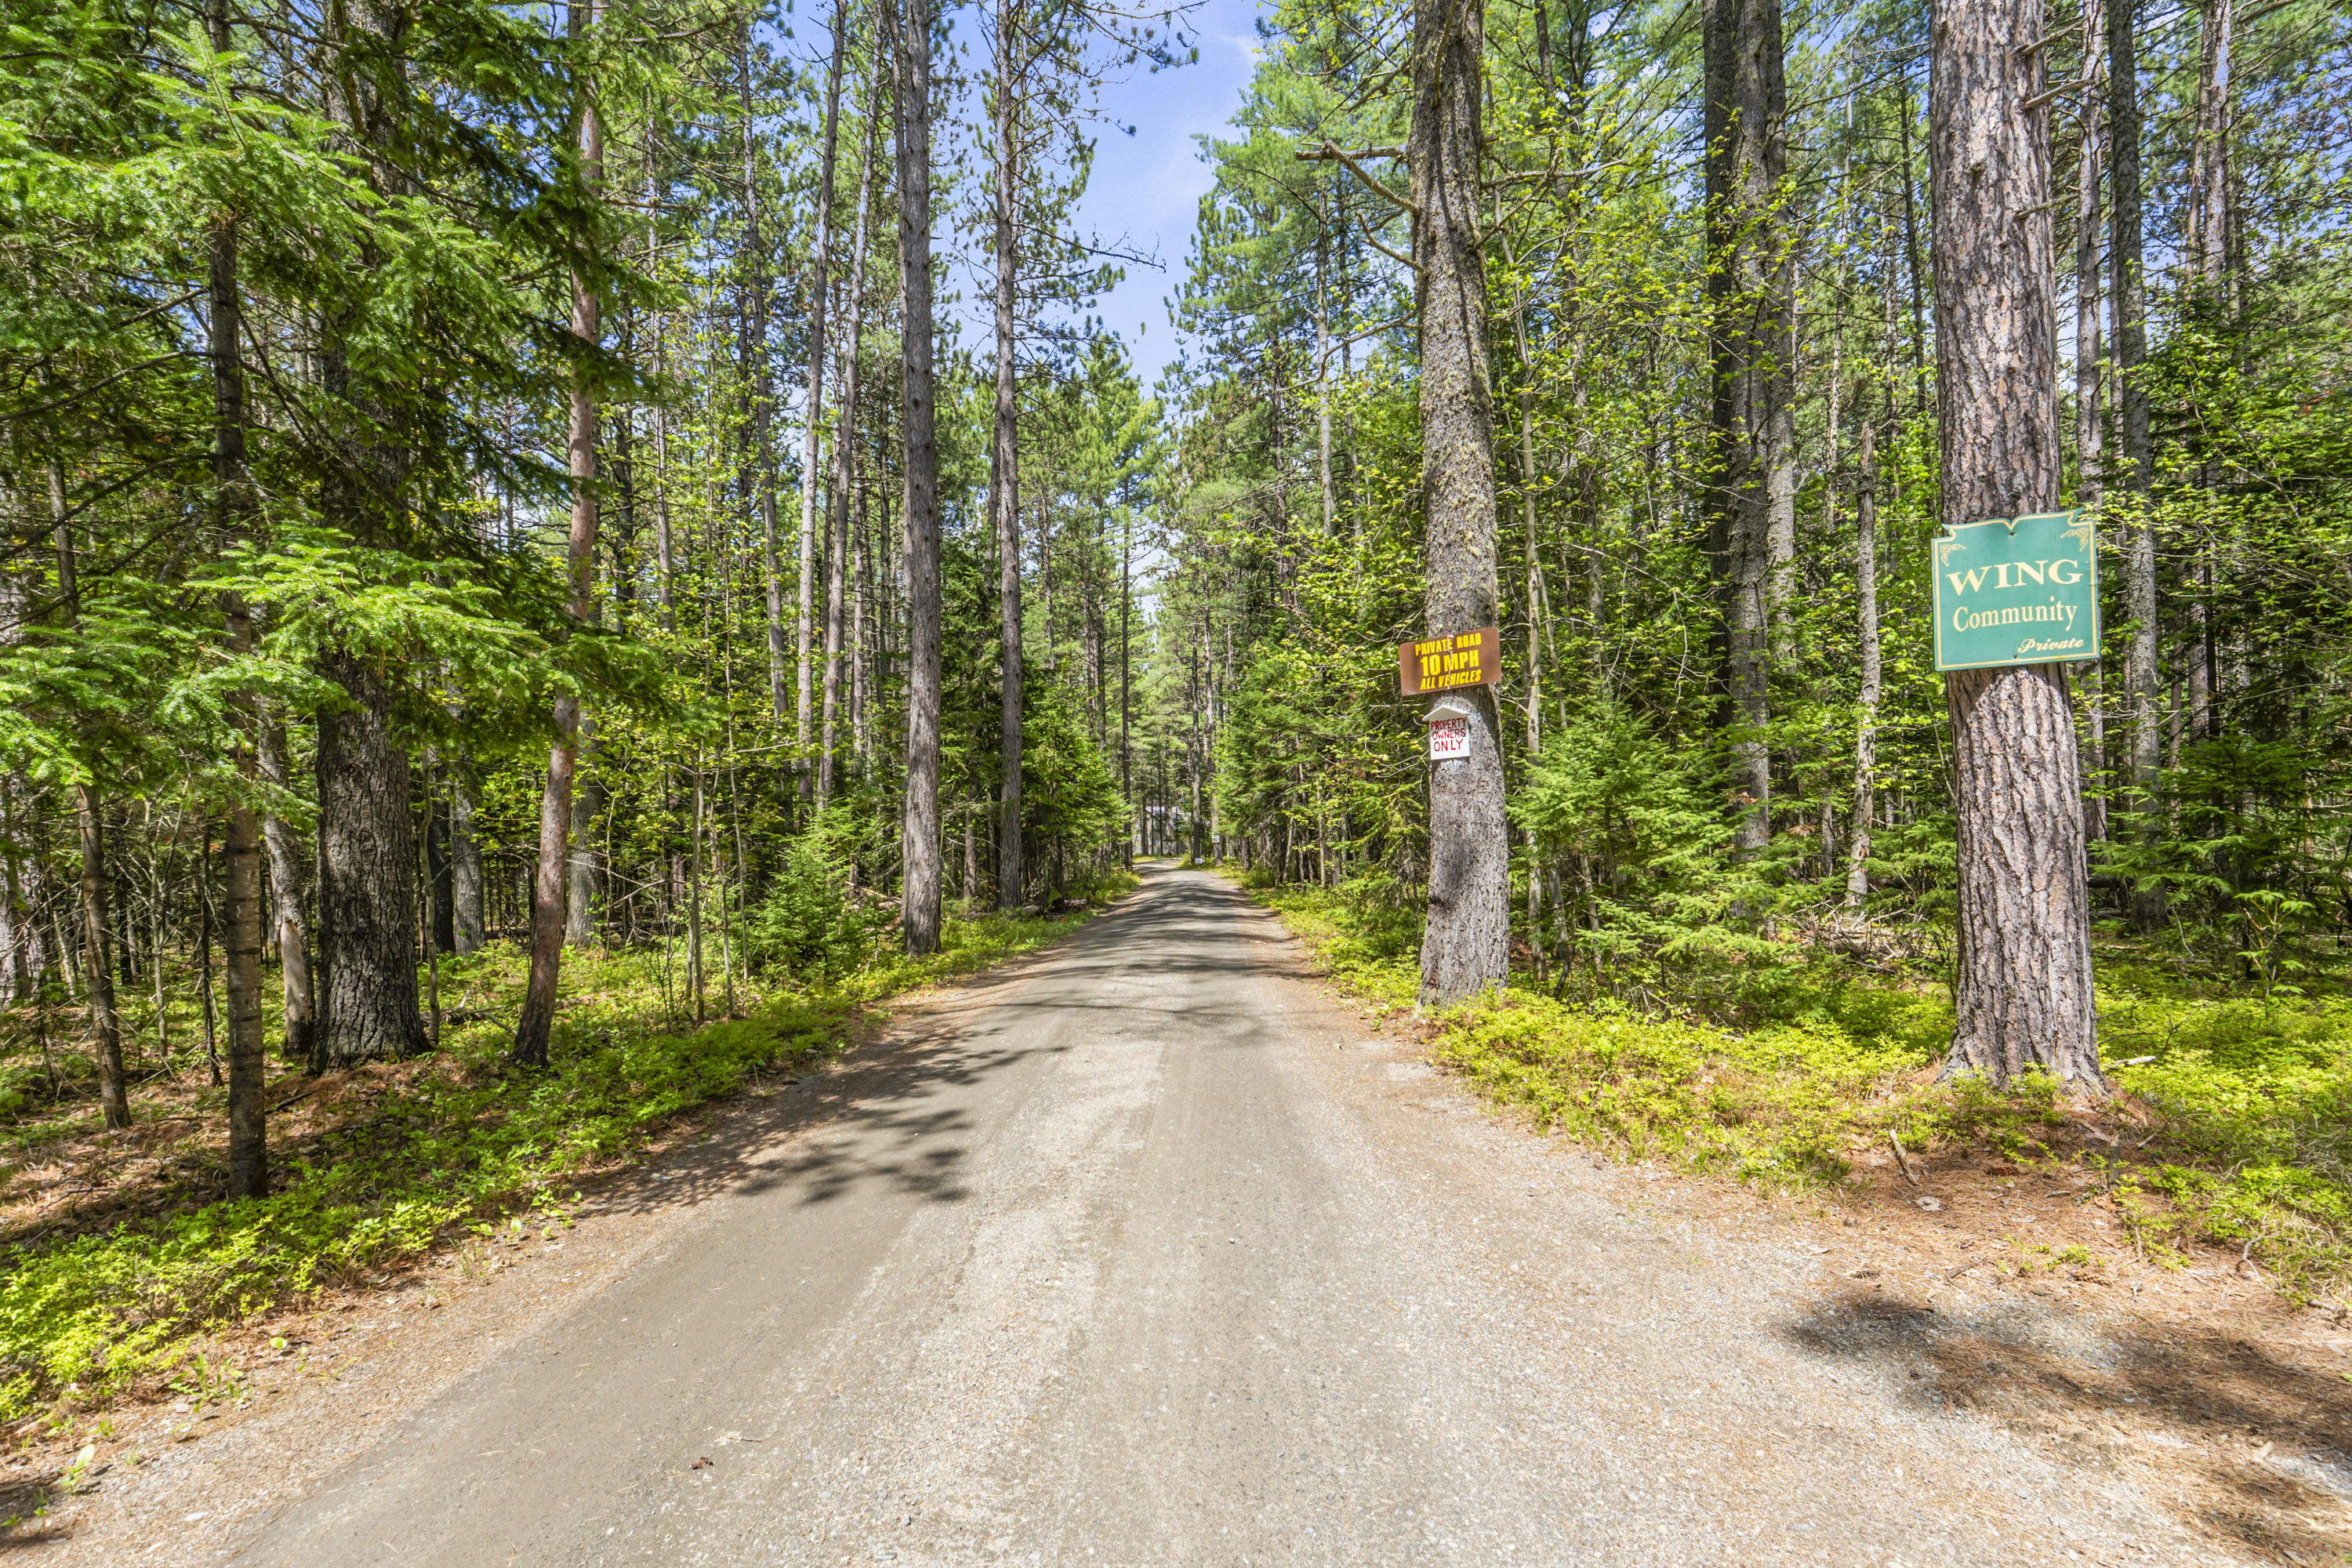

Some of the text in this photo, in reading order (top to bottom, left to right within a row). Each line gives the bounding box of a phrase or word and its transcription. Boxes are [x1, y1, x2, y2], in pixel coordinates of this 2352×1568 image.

[1946, 559, 2084, 596] WING
[1953, 596, 2078, 632] Community
[1415, 633, 1482, 656] PRIVATE ROAD
[2017, 637, 2084, 653] Private
[1420, 649, 1479, 677] 10 MPH
[1420, 669, 1482, 690] ALL VEHICLES
[1431, 717, 1467, 731] PROPERTY
[1432, 728, 1466, 740] OWNERS
[1433, 738, 1464, 752] ONLY
